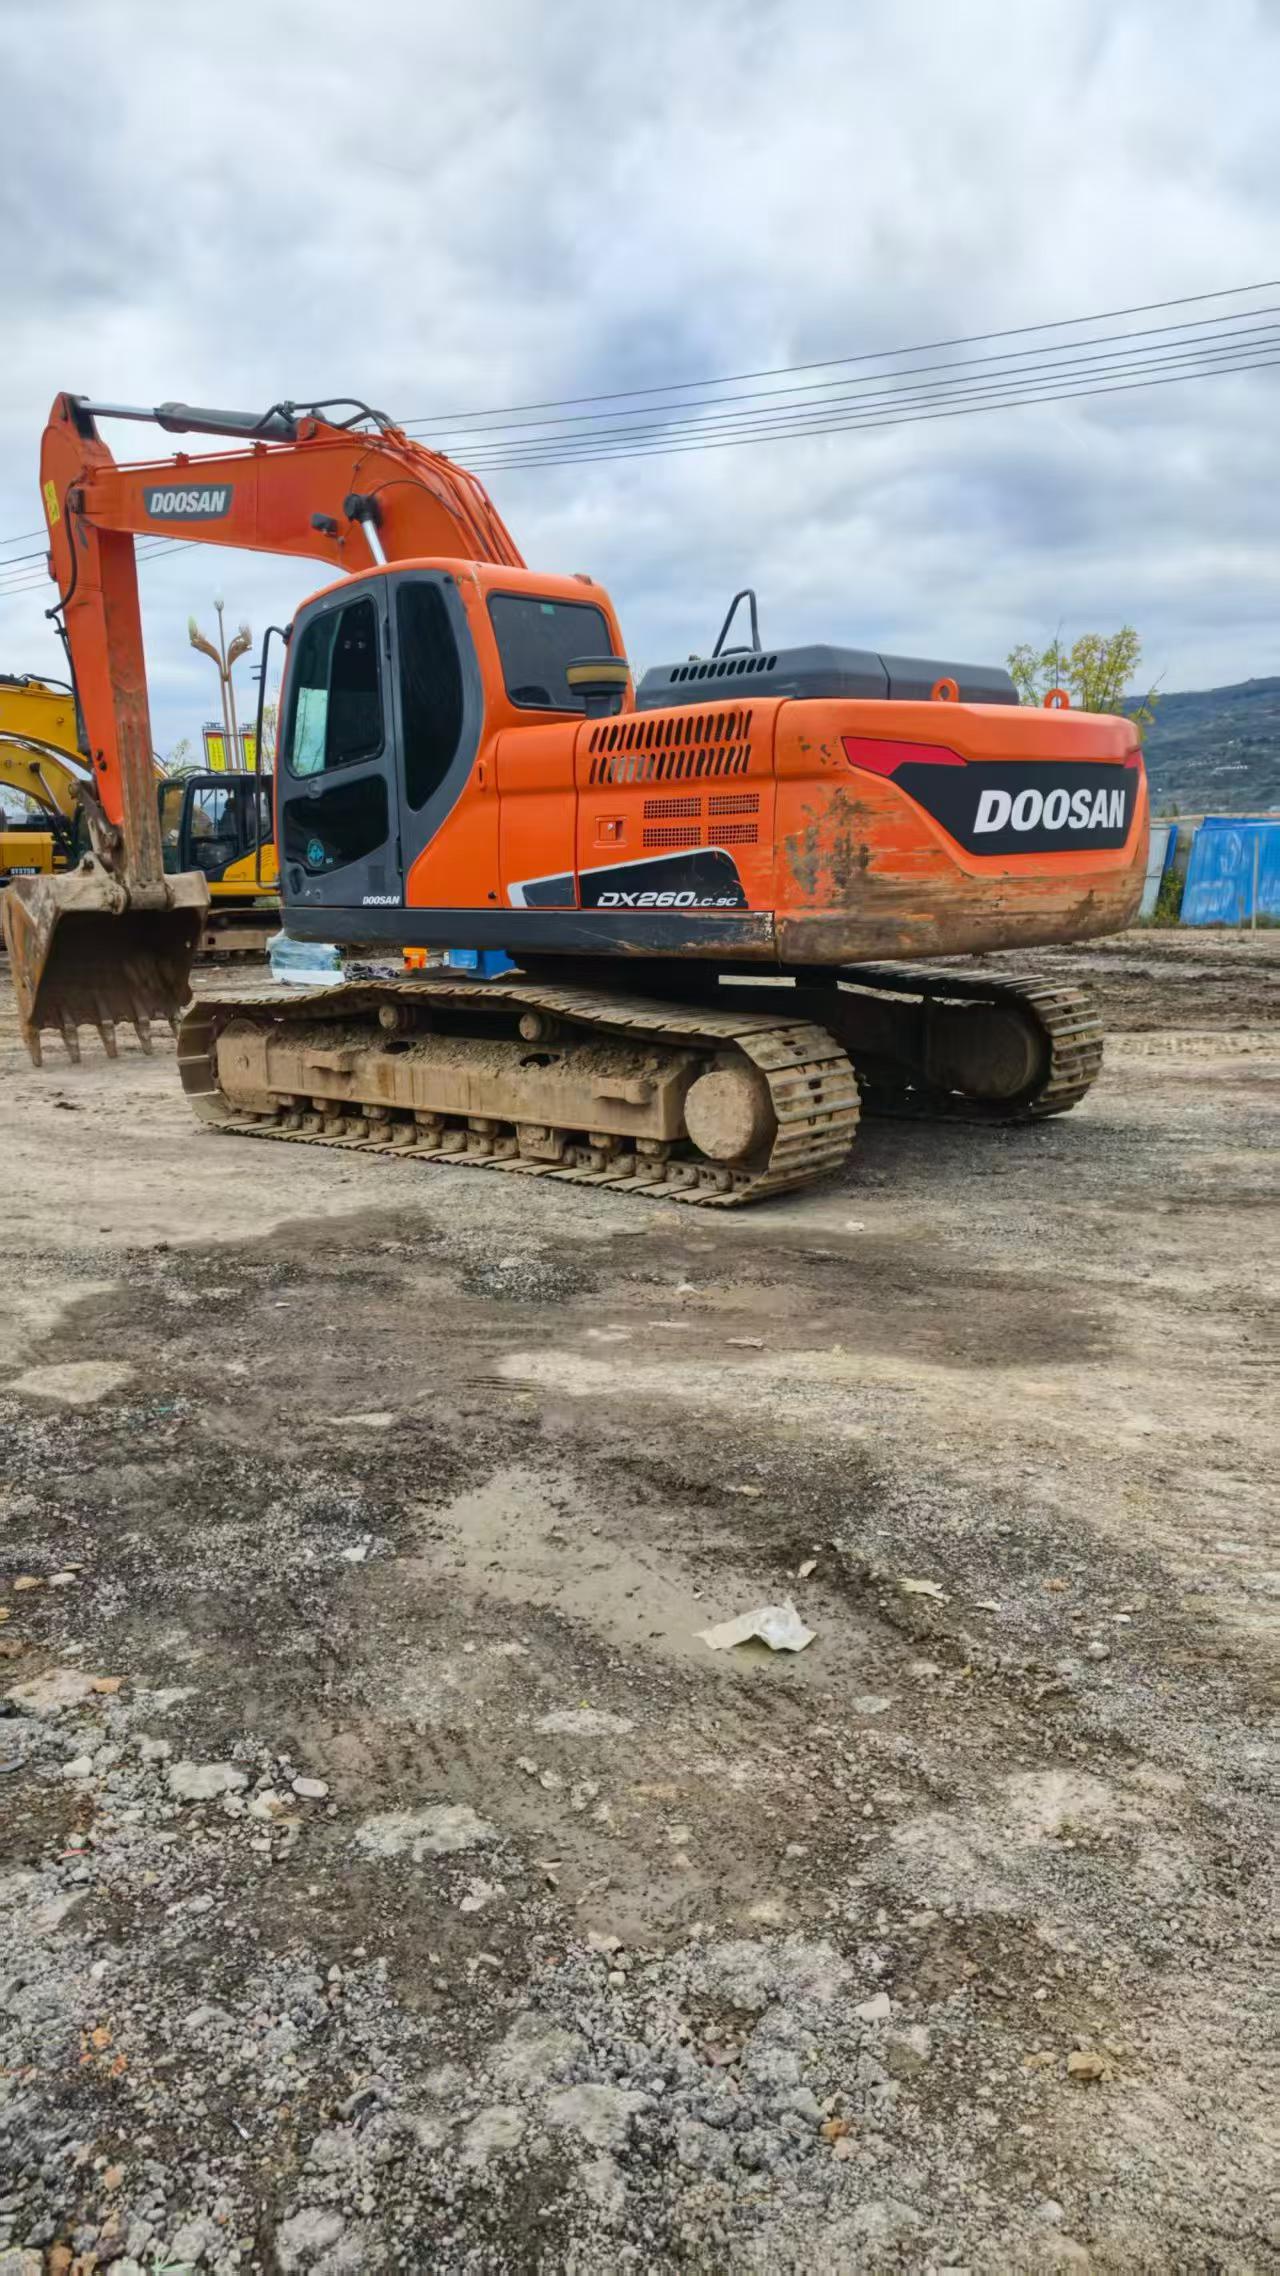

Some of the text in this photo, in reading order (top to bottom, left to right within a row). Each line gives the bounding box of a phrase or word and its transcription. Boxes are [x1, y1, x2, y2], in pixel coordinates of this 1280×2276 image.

[150, 490, 226, 513] DOOSAN
[973, 788, 1125, 833] DOOSAN
[362, 895, 400, 905] DOOSAN
